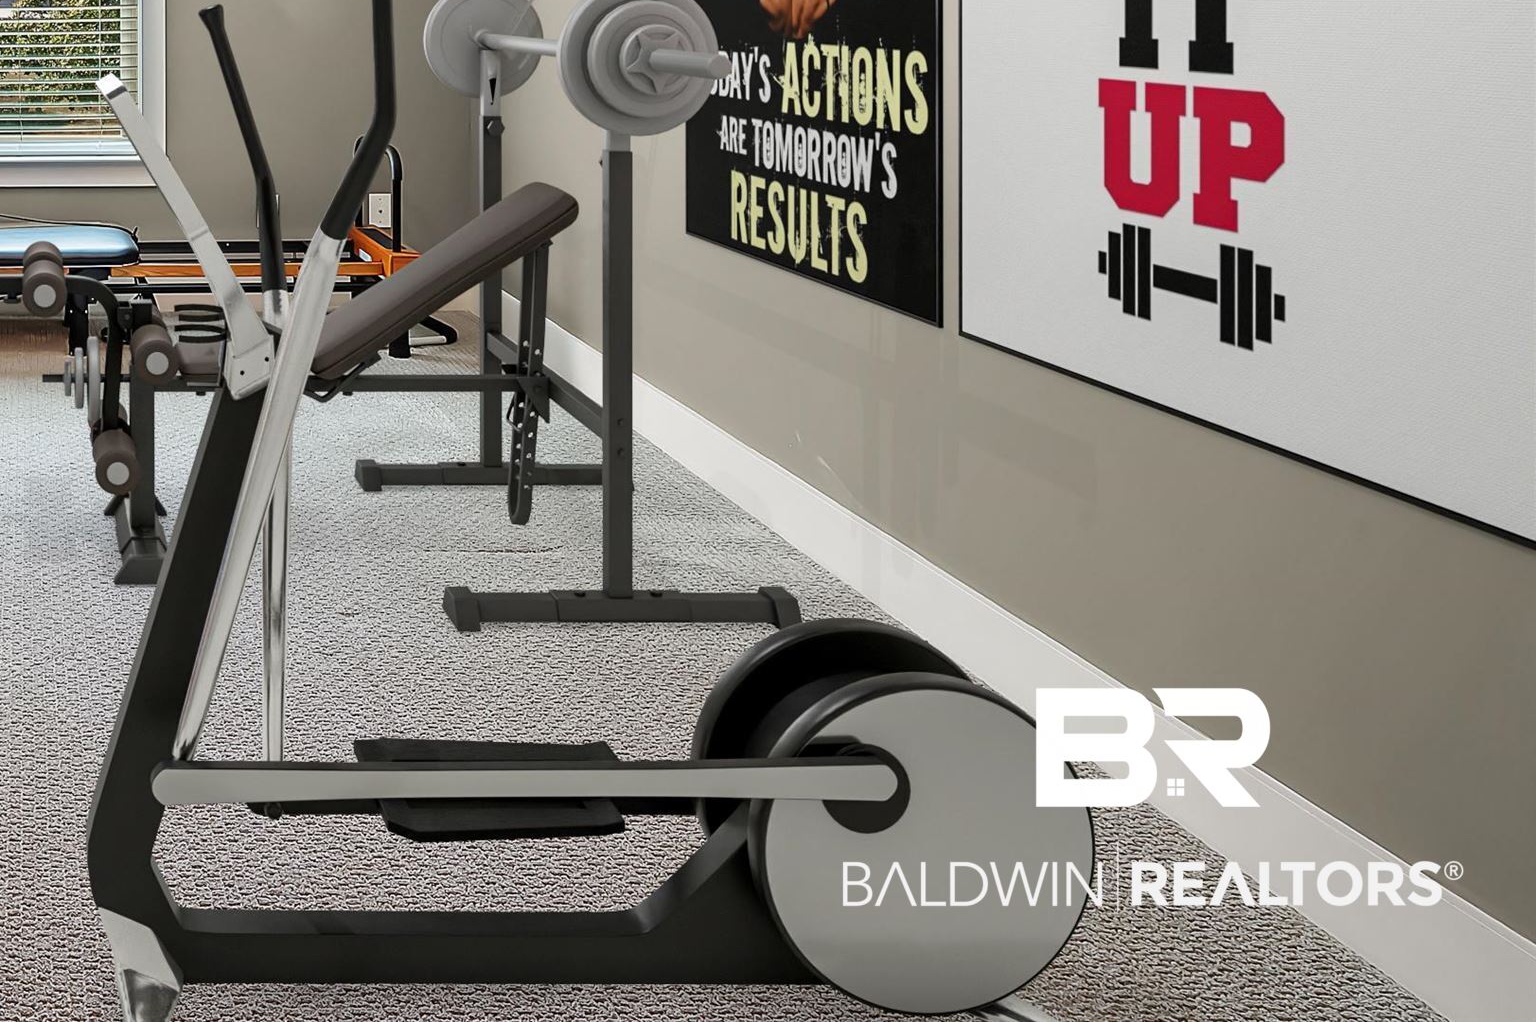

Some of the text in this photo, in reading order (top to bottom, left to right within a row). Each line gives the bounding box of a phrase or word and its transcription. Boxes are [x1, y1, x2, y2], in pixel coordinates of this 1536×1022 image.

[710, 38, 929, 136] DAY'S ACTIONS
[719, 115, 898, 200] ARE TOMORROW'S
[1098, 77, 1285, 233] UP
[730, 169, 869, 284] RESULTS
